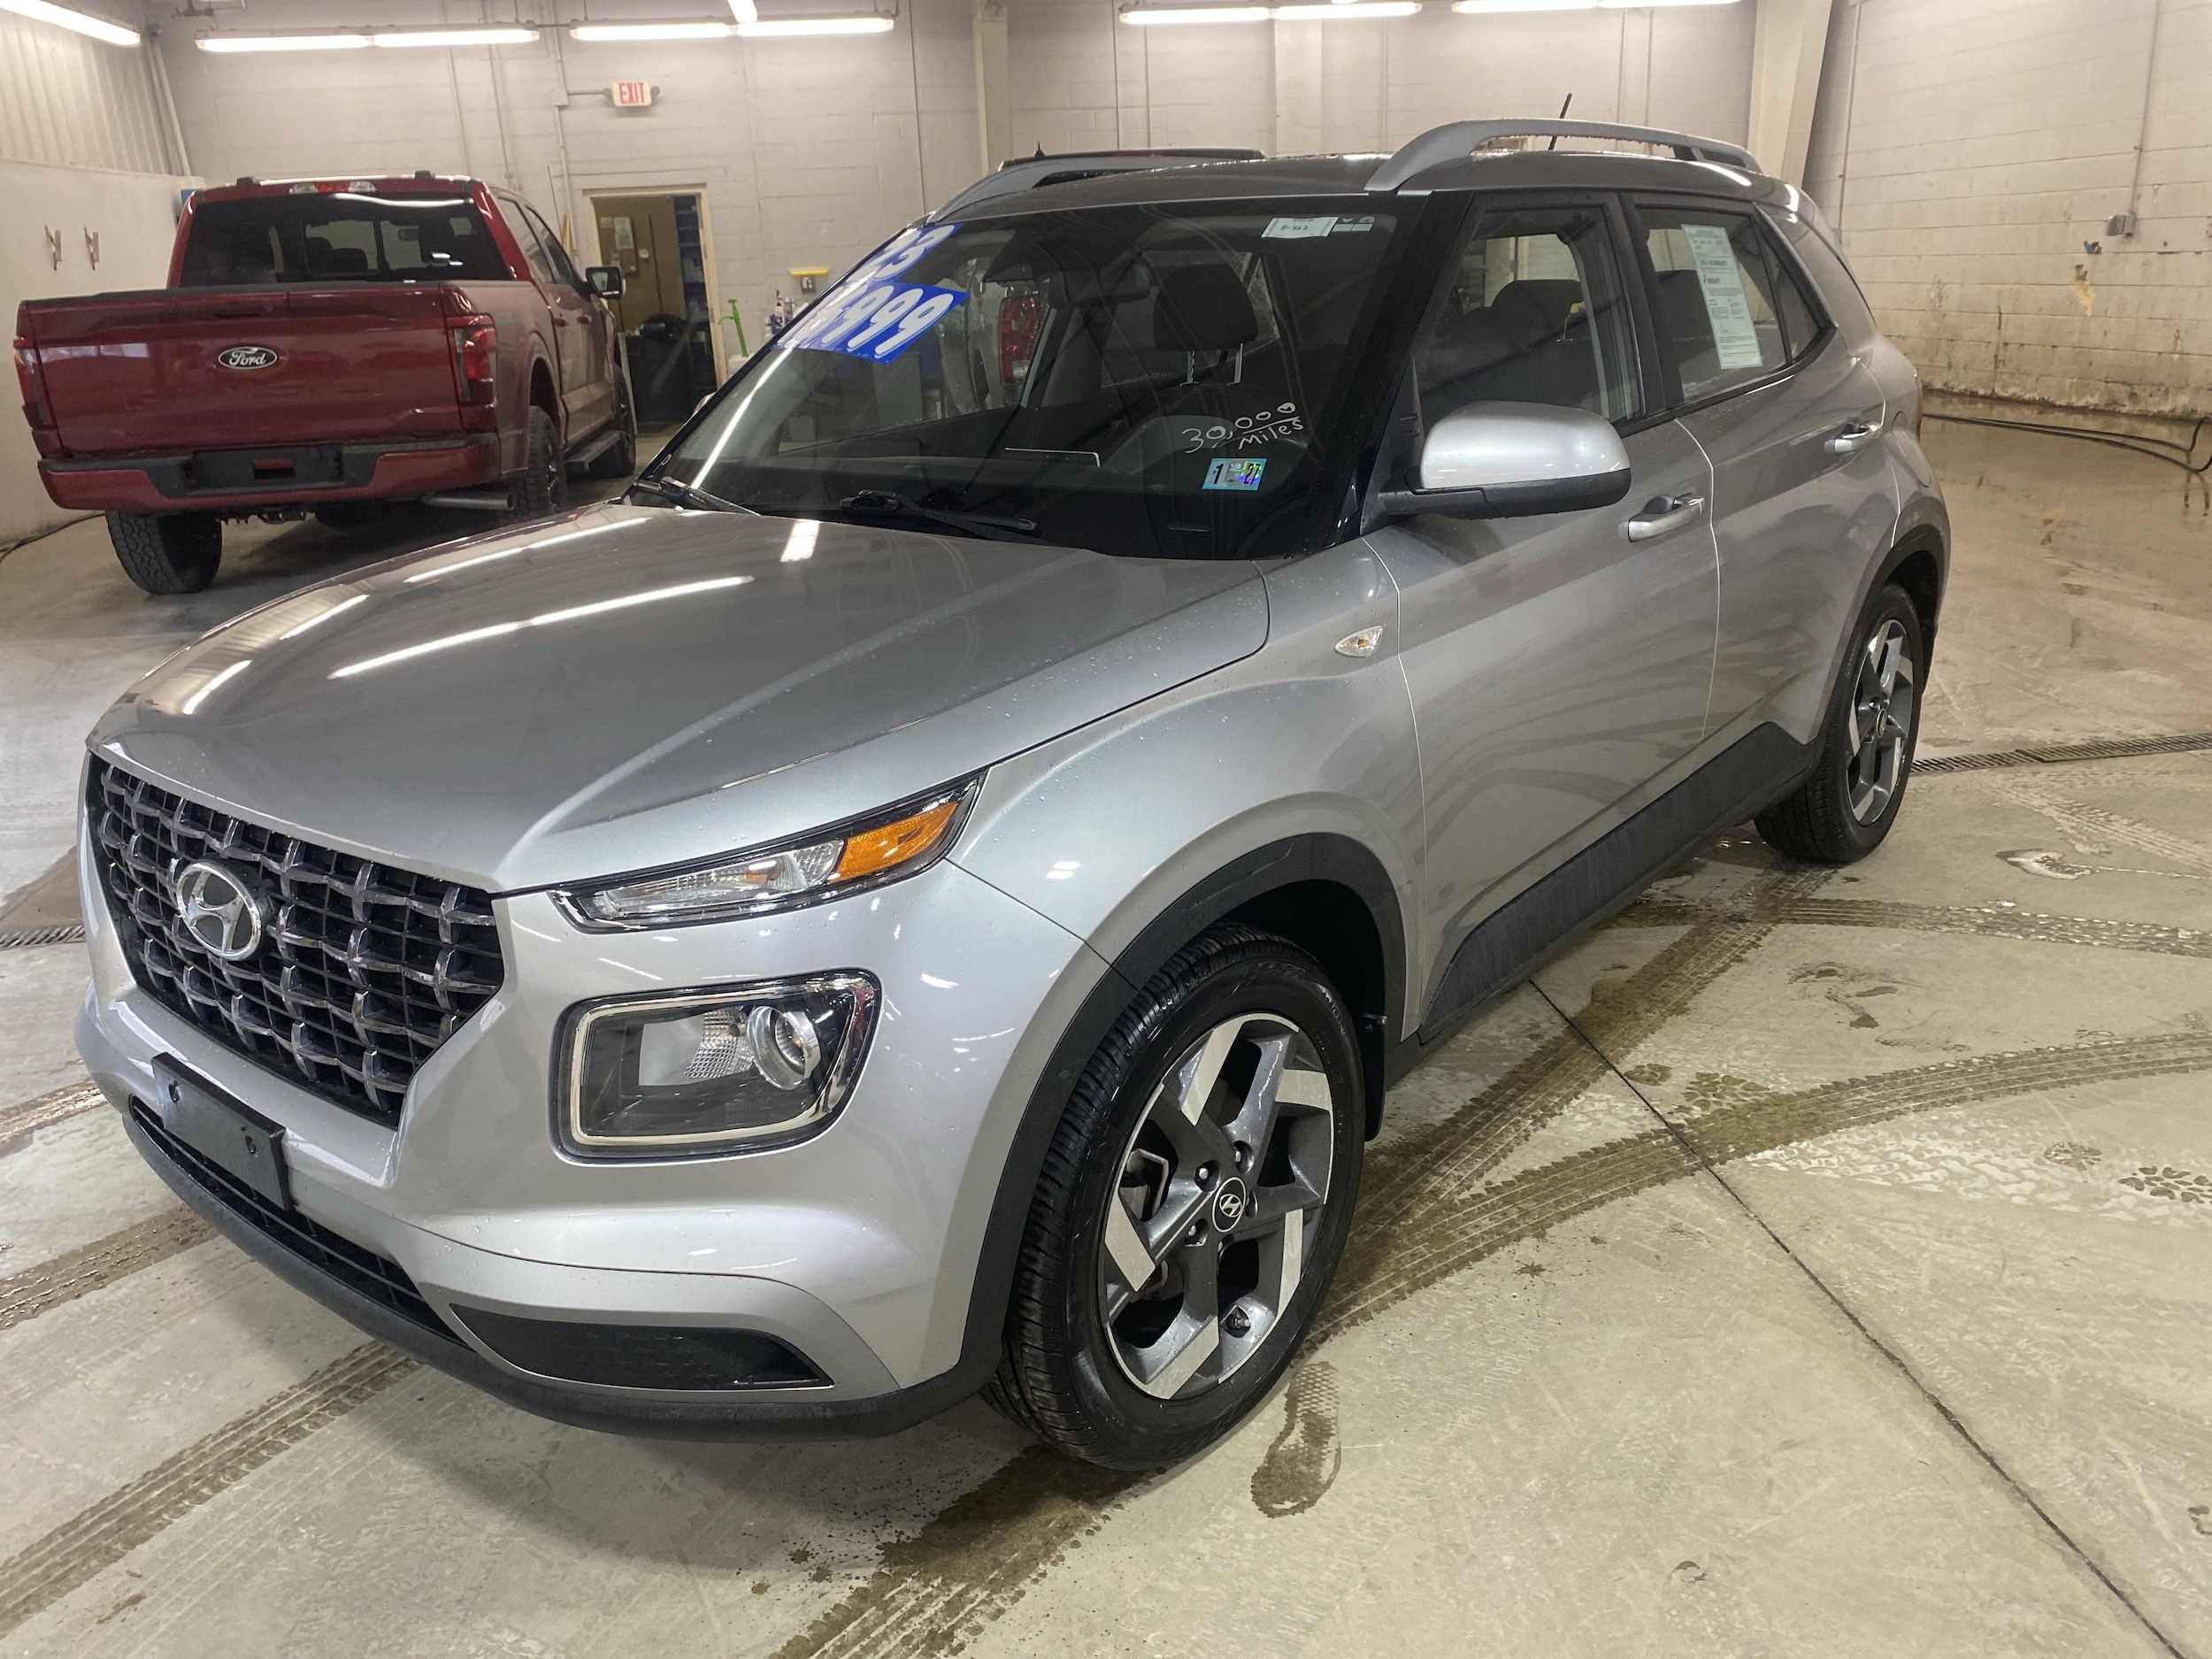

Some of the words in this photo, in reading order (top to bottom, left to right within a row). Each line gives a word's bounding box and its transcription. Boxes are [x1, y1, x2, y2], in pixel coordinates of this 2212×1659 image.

[618, 82, 645, 104] EXIT
[229, 349, 266, 365] Ford
[1181, 403, 1296, 454] 30,000
[1213, 464, 1224, 484] 1
[1243, 464, 1261, 486] 27
